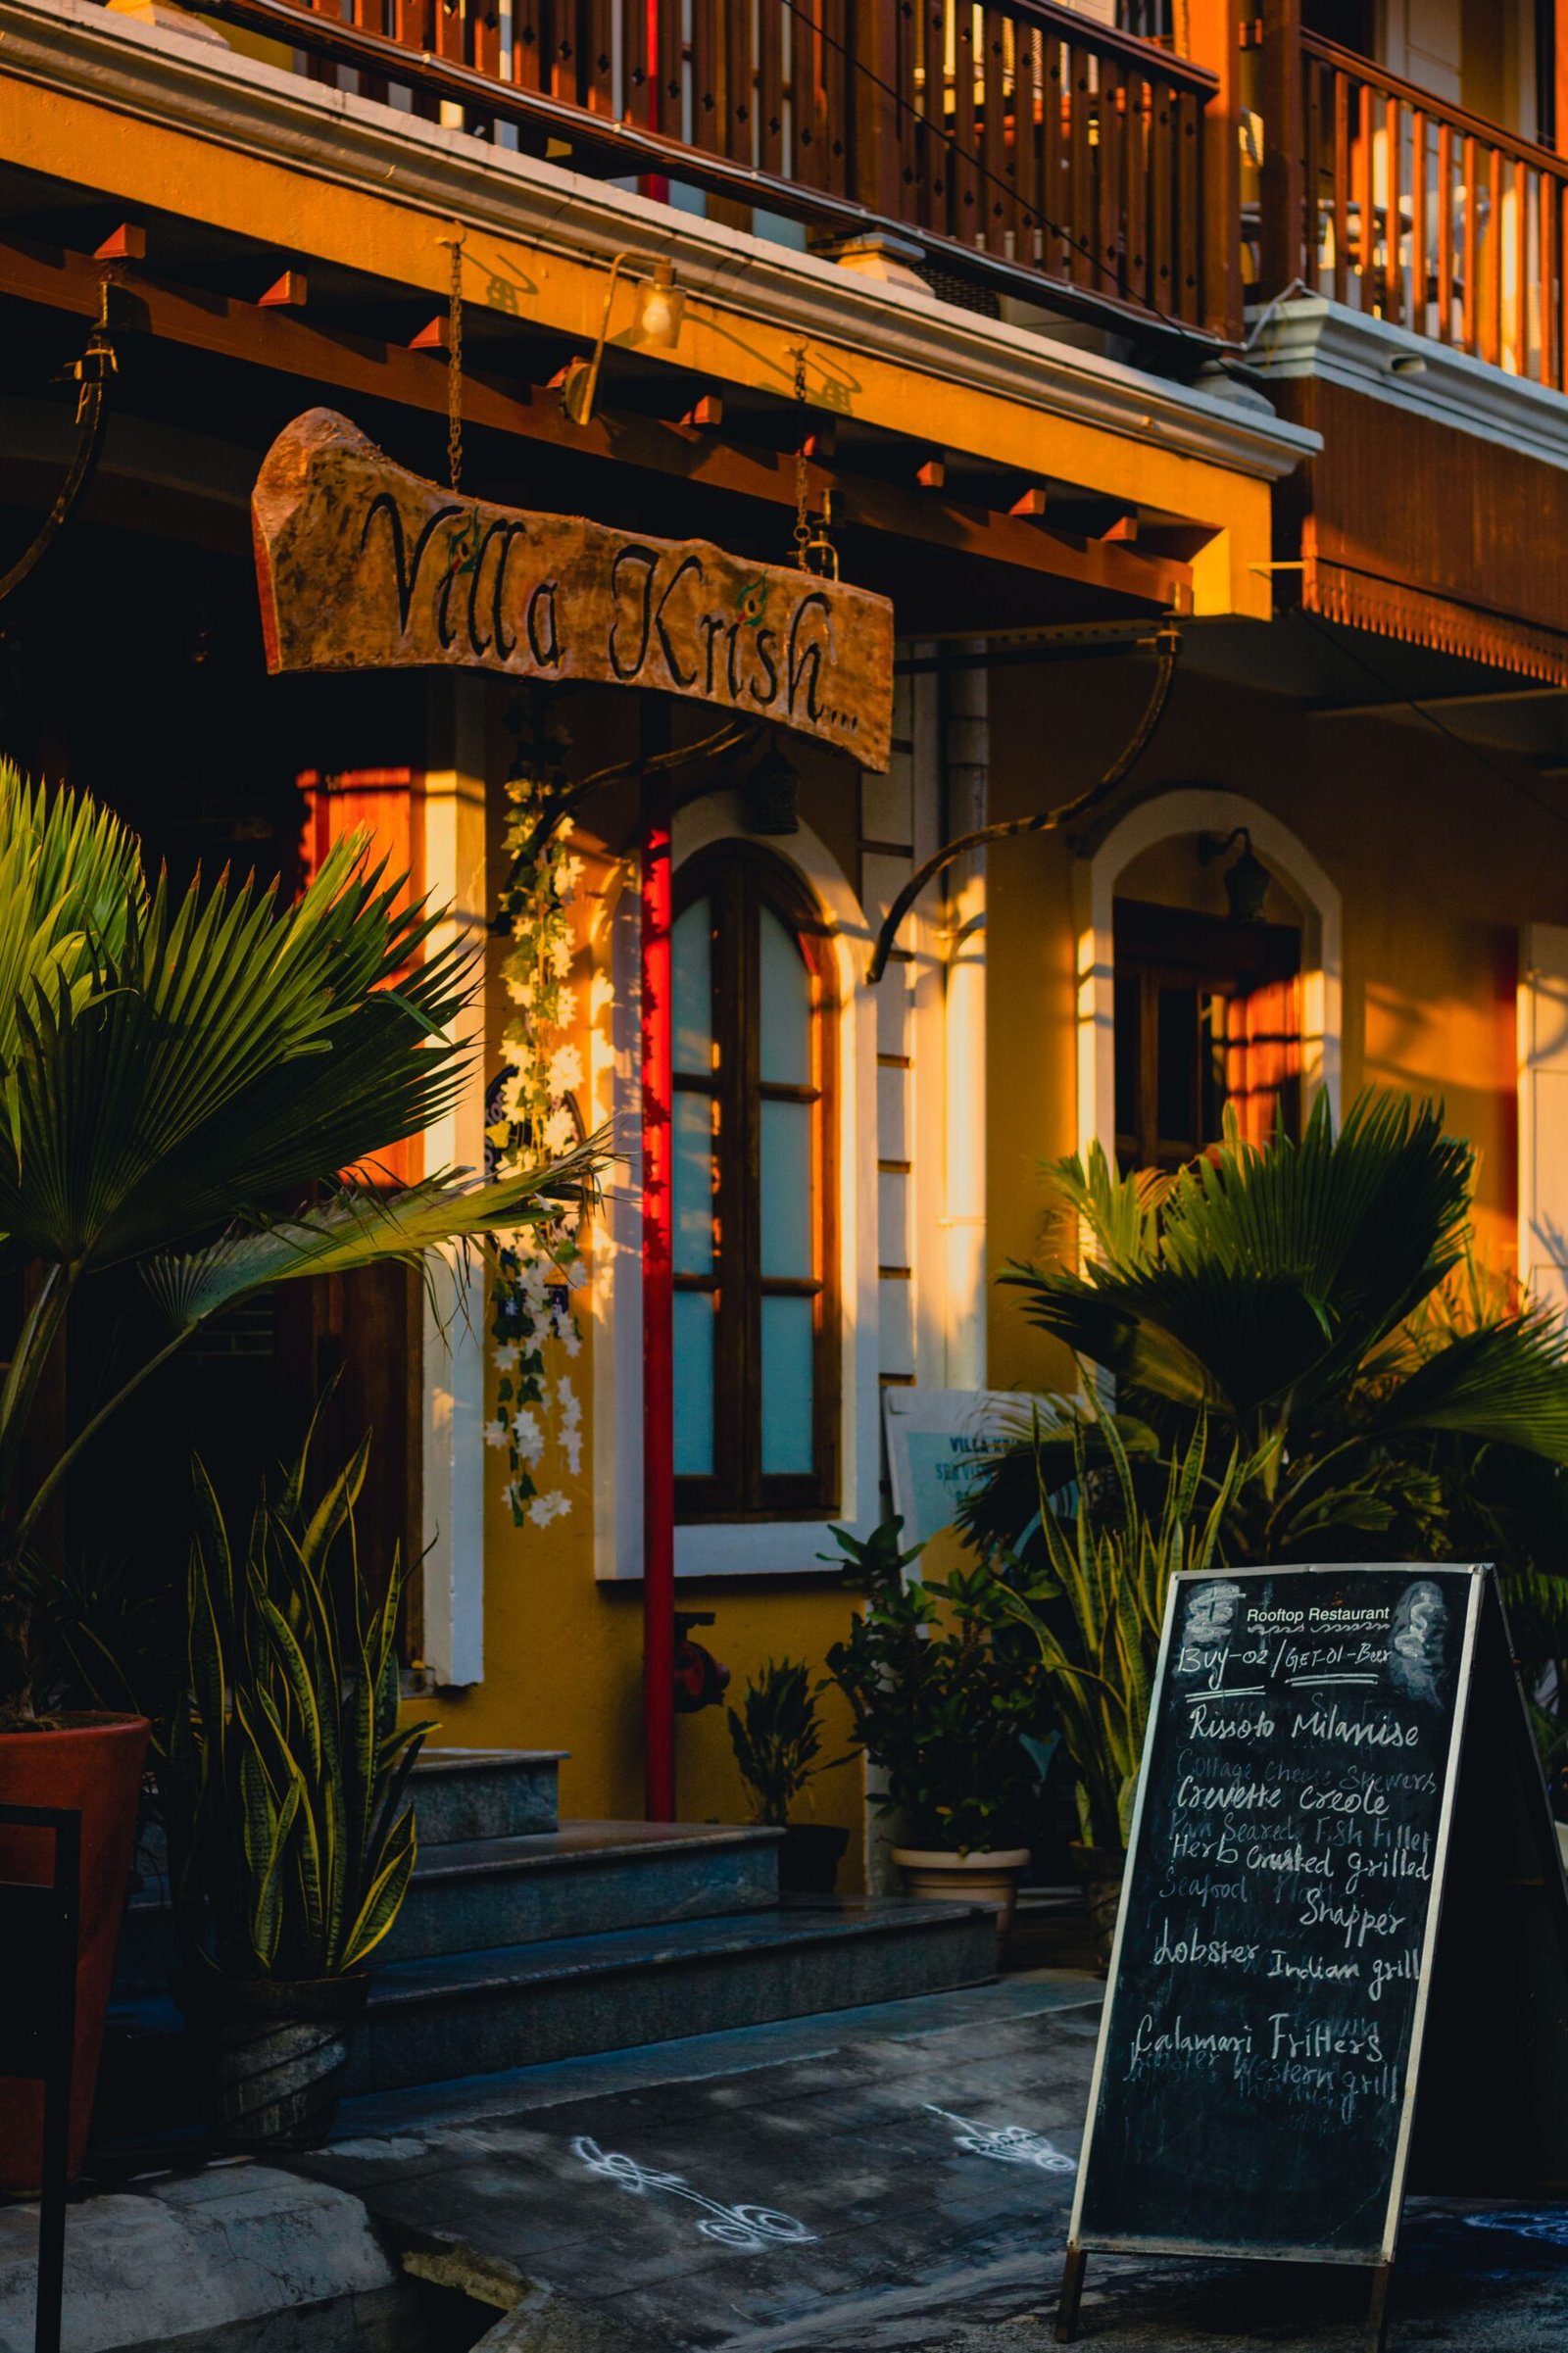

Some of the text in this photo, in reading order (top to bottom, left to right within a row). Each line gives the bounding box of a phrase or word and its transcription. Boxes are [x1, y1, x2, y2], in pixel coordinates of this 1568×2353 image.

[363, 493, 565, 669] Villa
[1247, 1606, 1390, 1623] Rooftop Restaurant
